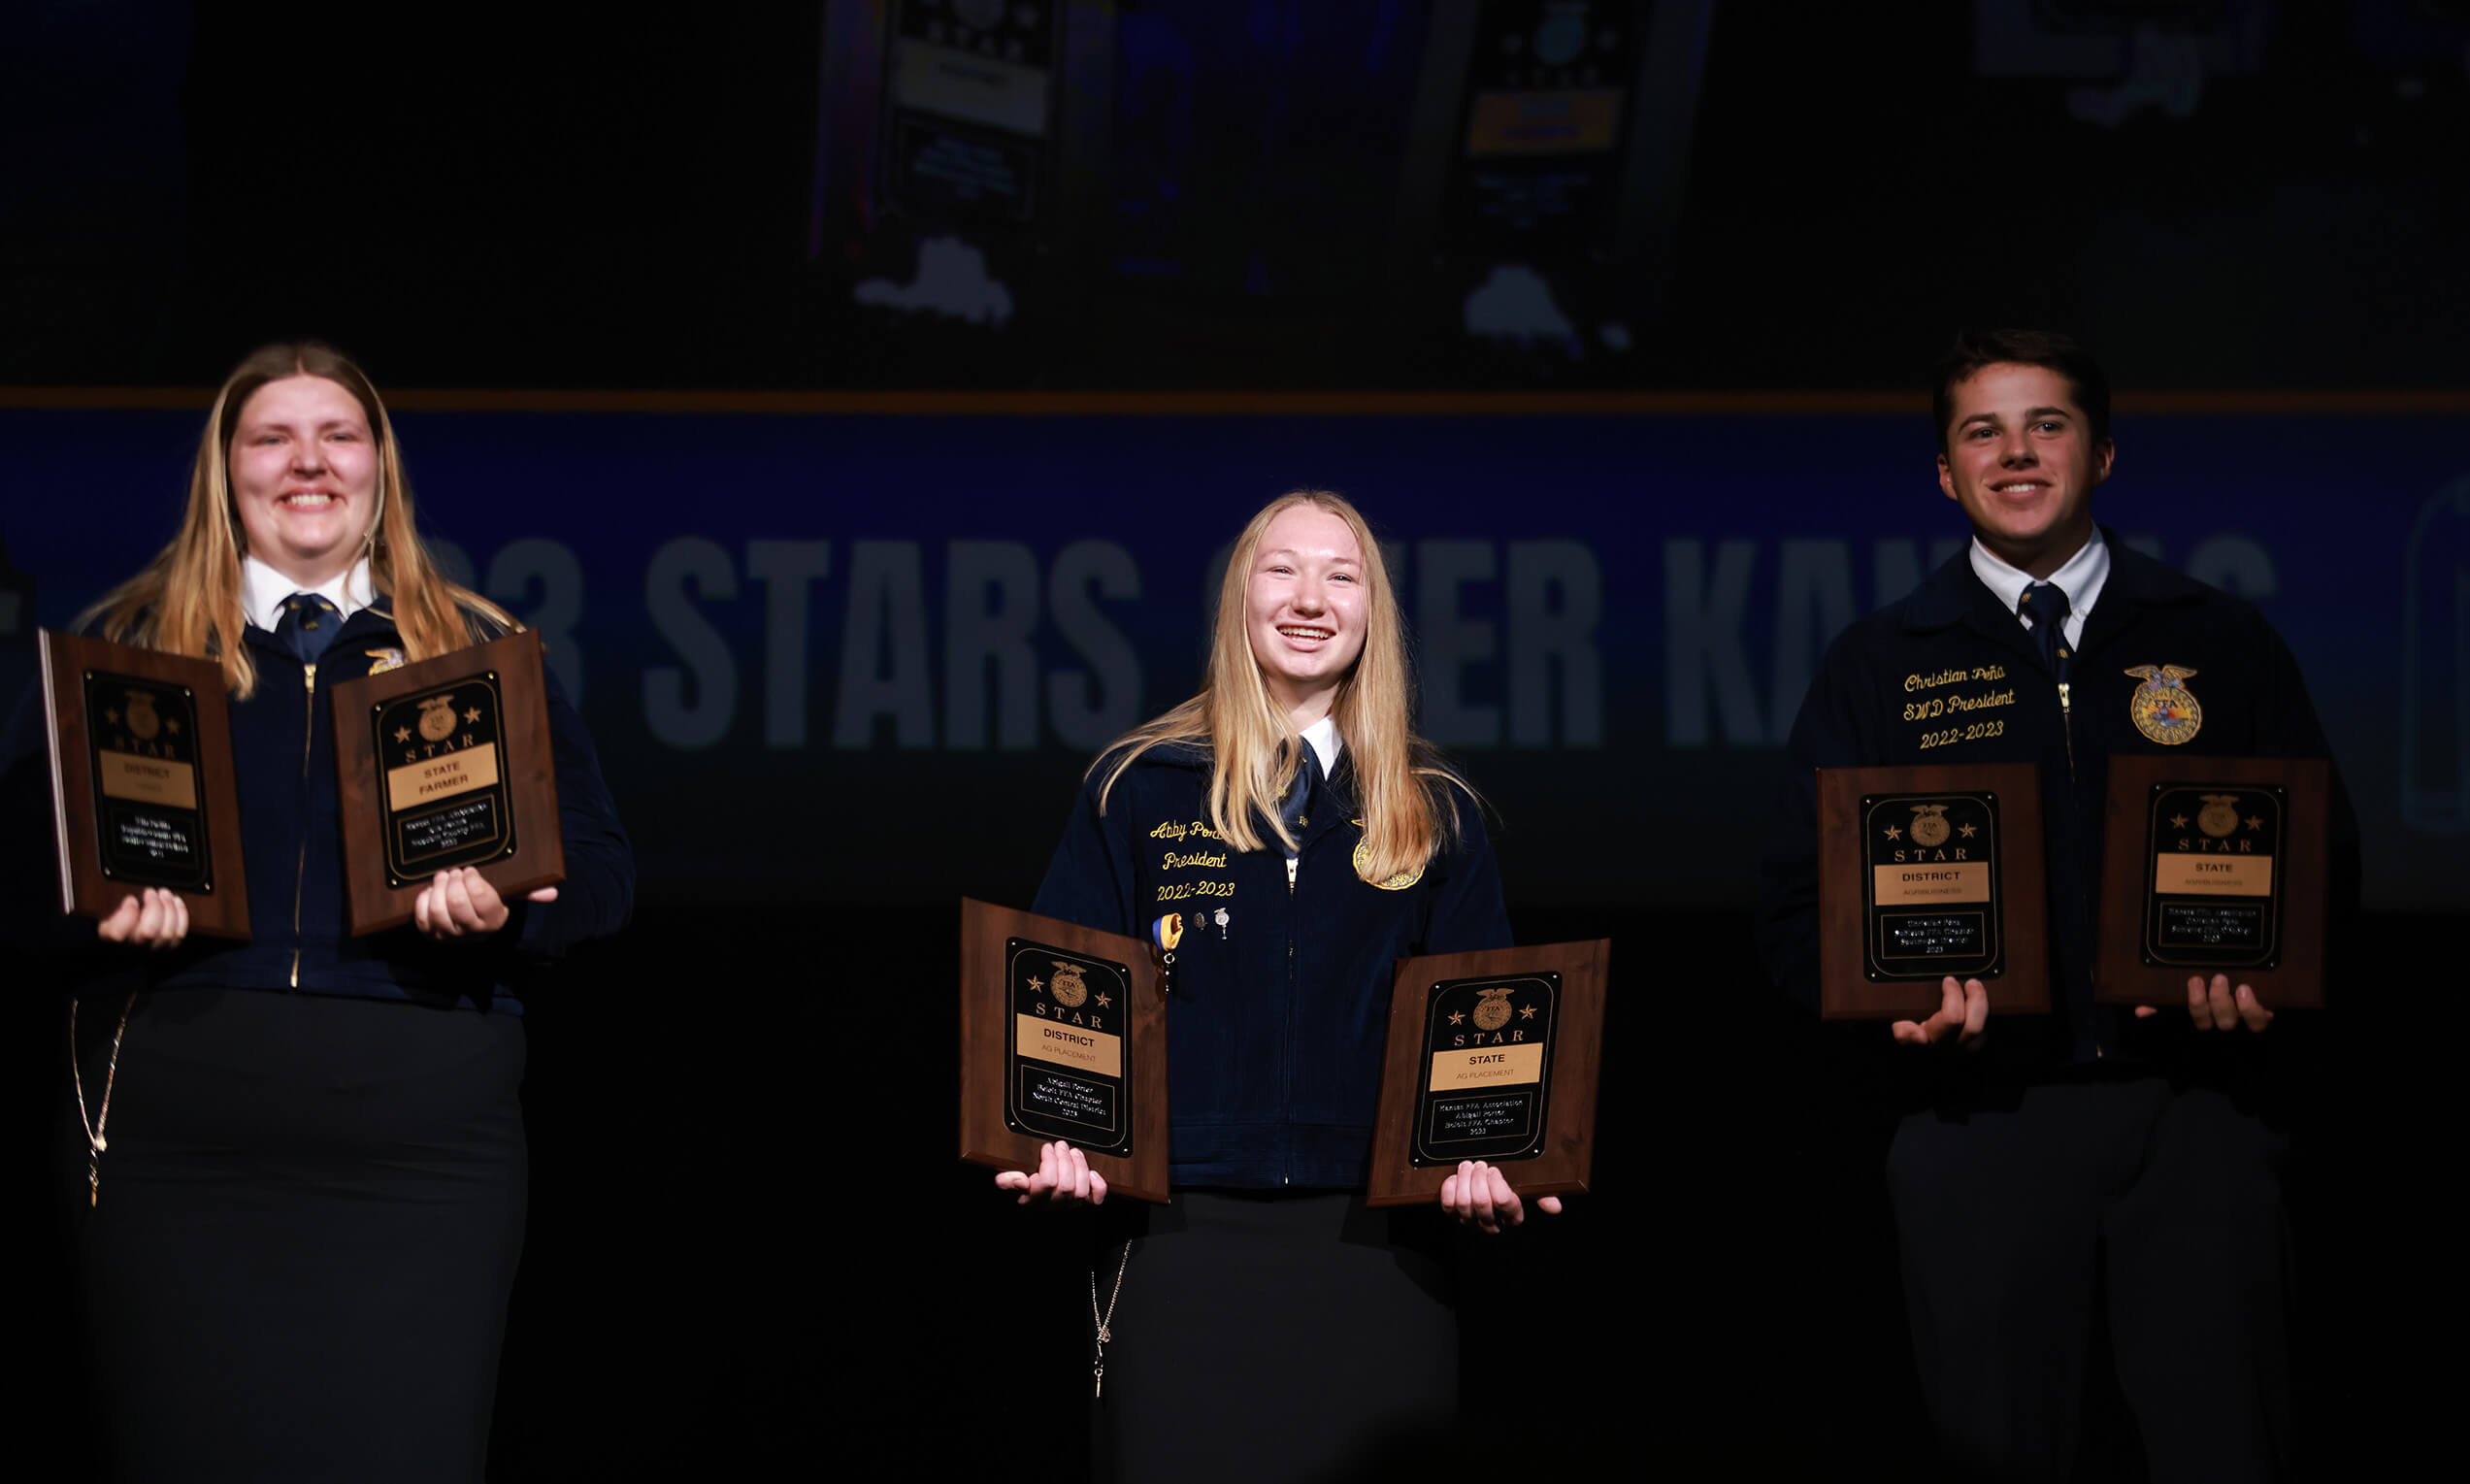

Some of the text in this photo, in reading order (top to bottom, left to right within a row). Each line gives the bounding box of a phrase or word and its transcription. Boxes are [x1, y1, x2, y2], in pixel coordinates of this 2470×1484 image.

[643, 535, 1142, 751] STARS
[1904, 669, 1967, 692] Christian
[1947, 688, 2016, 714] President
[1920, 719, 2005, 749] 2022-2023
[404, 732, 475, 764] STAR
[424, 761, 460, 778] STATE
[418, 775, 469, 795] FARMER
[1150, 819, 1187, 842] Abby
[1894, 848, 1967, 862] STAR
[2178, 839, 2252, 852] STAR
[1162, 850, 1228, 870] President
[2195, 863, 2233, 873] STATE
[1902, 872, 1960, 882] DISTRICT
[1157, 880, 1235, 902] 2022-2023
[1036, 1002, 1103, 1029] STAR
[1043, 1028, 1095, 1047] DISTRICT
[1454, 1030, 1524, 1046] STAR
[1468, 1054, 1505, 1066] STATE
